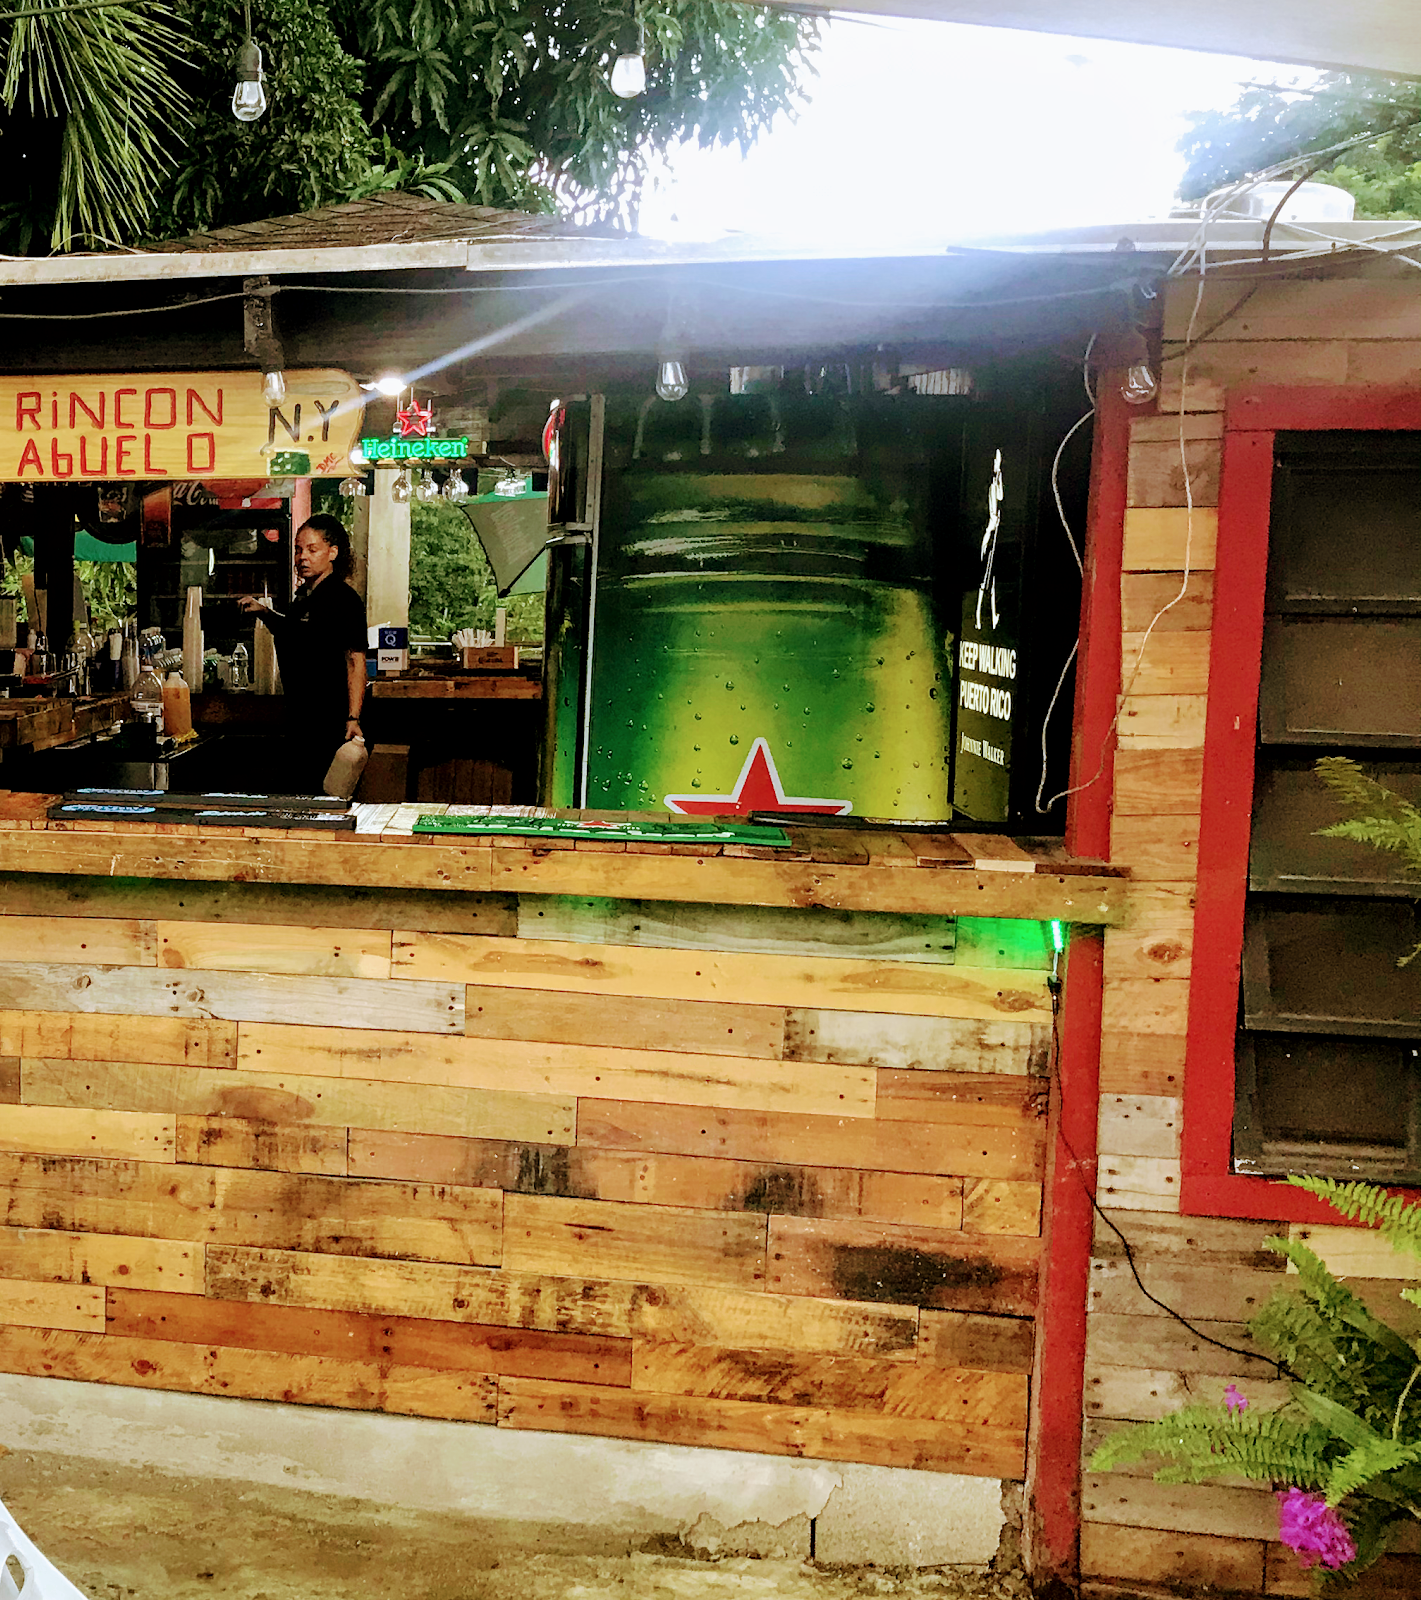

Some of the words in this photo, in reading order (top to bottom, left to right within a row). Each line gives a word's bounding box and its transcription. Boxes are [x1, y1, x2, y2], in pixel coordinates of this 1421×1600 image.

[268, 400, 340, 442] N.Y
[361, 436, 469, 459] Heineken
[959, 640, 979, 671] KEEP
[978, 644, 1017, 680] WALKING
[959, 679, 990, 715] PUERTO
[989, 687, 1012, 721] RICO
